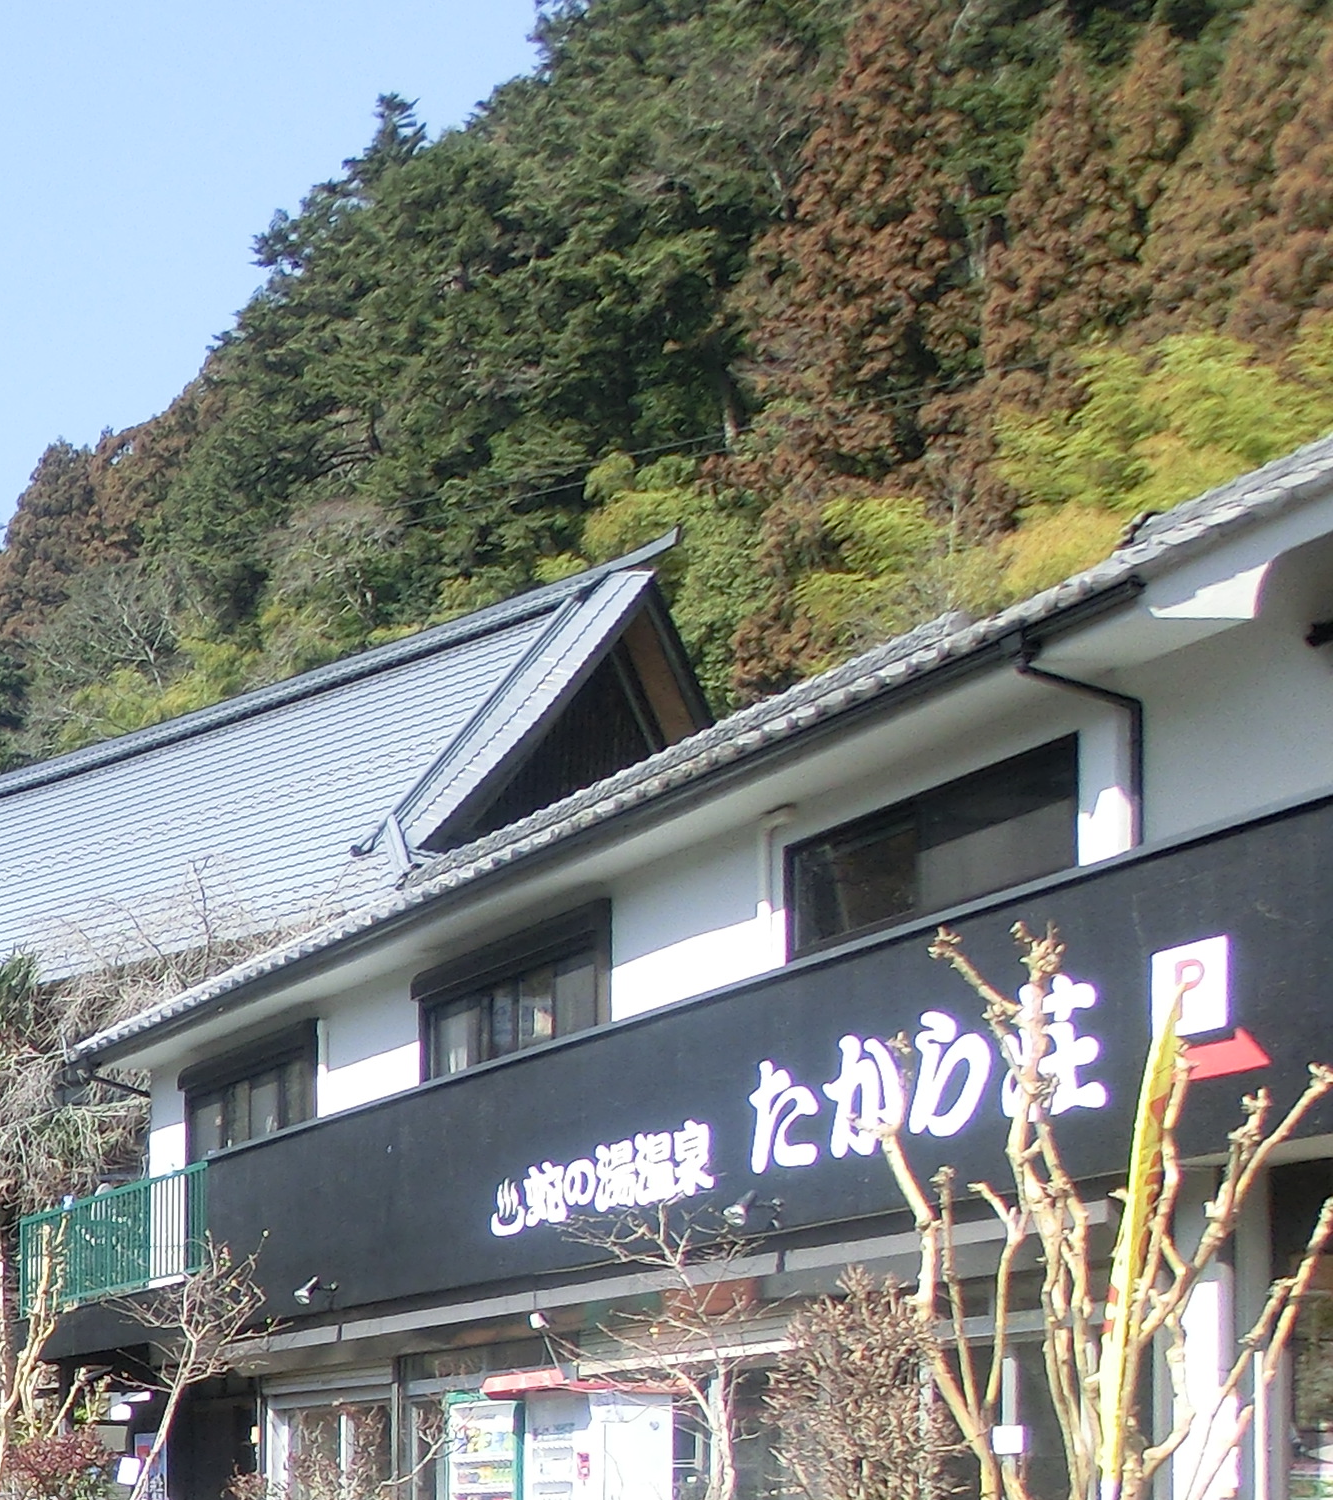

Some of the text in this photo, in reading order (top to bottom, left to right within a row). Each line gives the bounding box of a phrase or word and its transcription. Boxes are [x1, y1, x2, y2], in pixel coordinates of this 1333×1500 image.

[1175, 958, 1205, 1022] P
[749, 974, 1109, 1174] たから荘
[523, 1119, 715, 1227] 蛇の湯温泉
